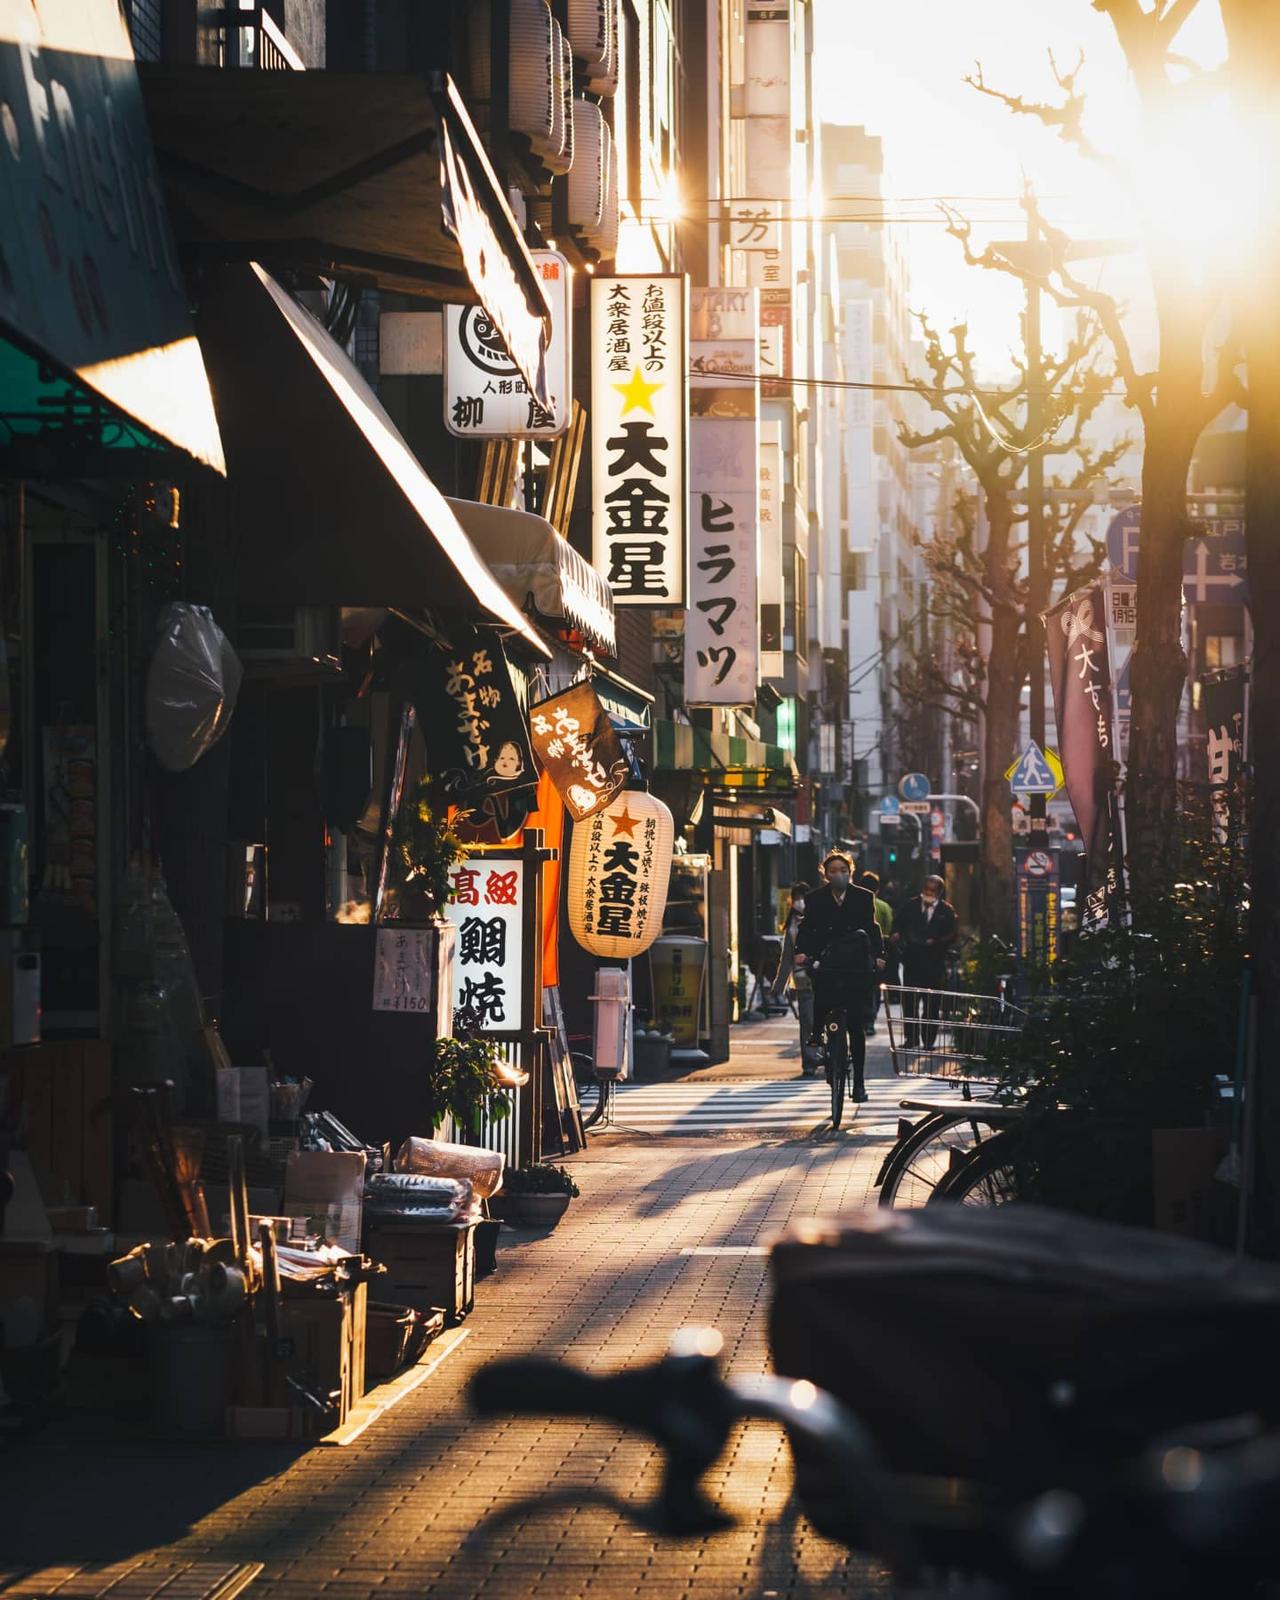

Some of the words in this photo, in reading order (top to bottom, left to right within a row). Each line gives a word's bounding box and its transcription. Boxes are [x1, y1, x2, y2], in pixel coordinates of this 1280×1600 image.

[606, 283, 631, 372] 大衆居酒屋
[641, 283, 666, 372] お値段以上の
[604, 421, 670, 598] 大金星
[696, 493, 737, 687] ヒラマツ
[583, 875, 597, 934] 大衆居酒屋
[596, 841, 640, 938] 大金星
